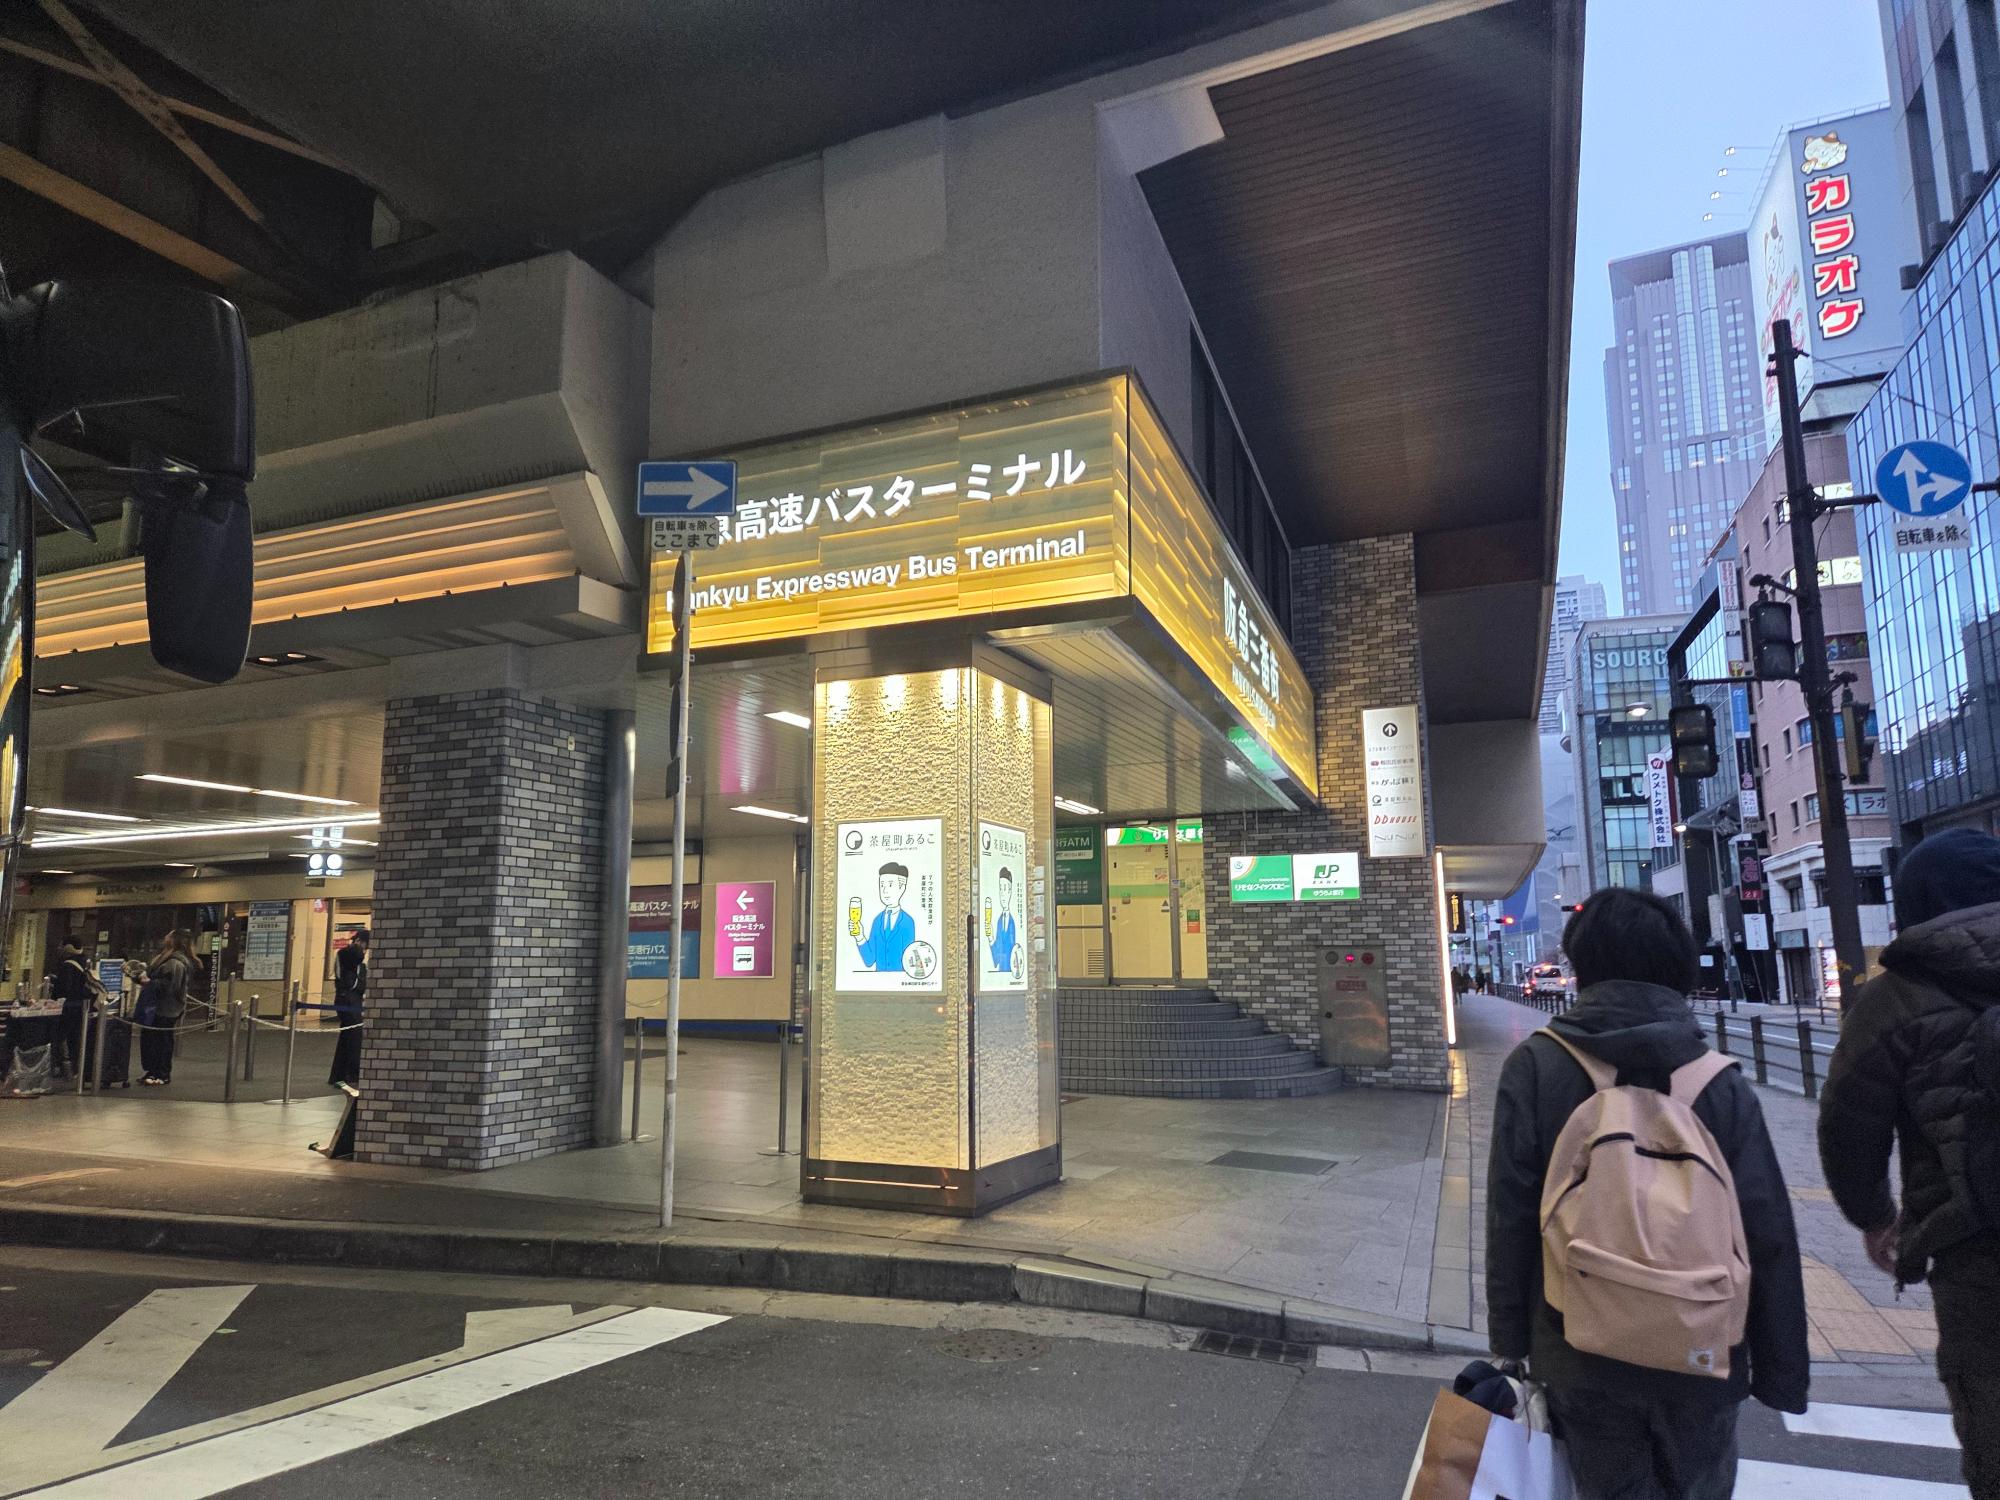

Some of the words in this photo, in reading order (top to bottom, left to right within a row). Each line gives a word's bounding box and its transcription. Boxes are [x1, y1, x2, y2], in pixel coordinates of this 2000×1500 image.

[1806, 175, 1862, 338] カラオケ
[654, 520, 717, 532] 自転車を除く
[1896, 524, 1969, 547] 自転車を除く
[653, 533, 717, 548] ここまで
[756, 563, 901, 602] Expressway
[908, 554, 958, 581] Bus
[965, 530, 1086, 571] Terminal
[1651, 772, 1667, 844] ウメトク株式会社
[869, 833, 936, 848] 茶屋町あるこ
